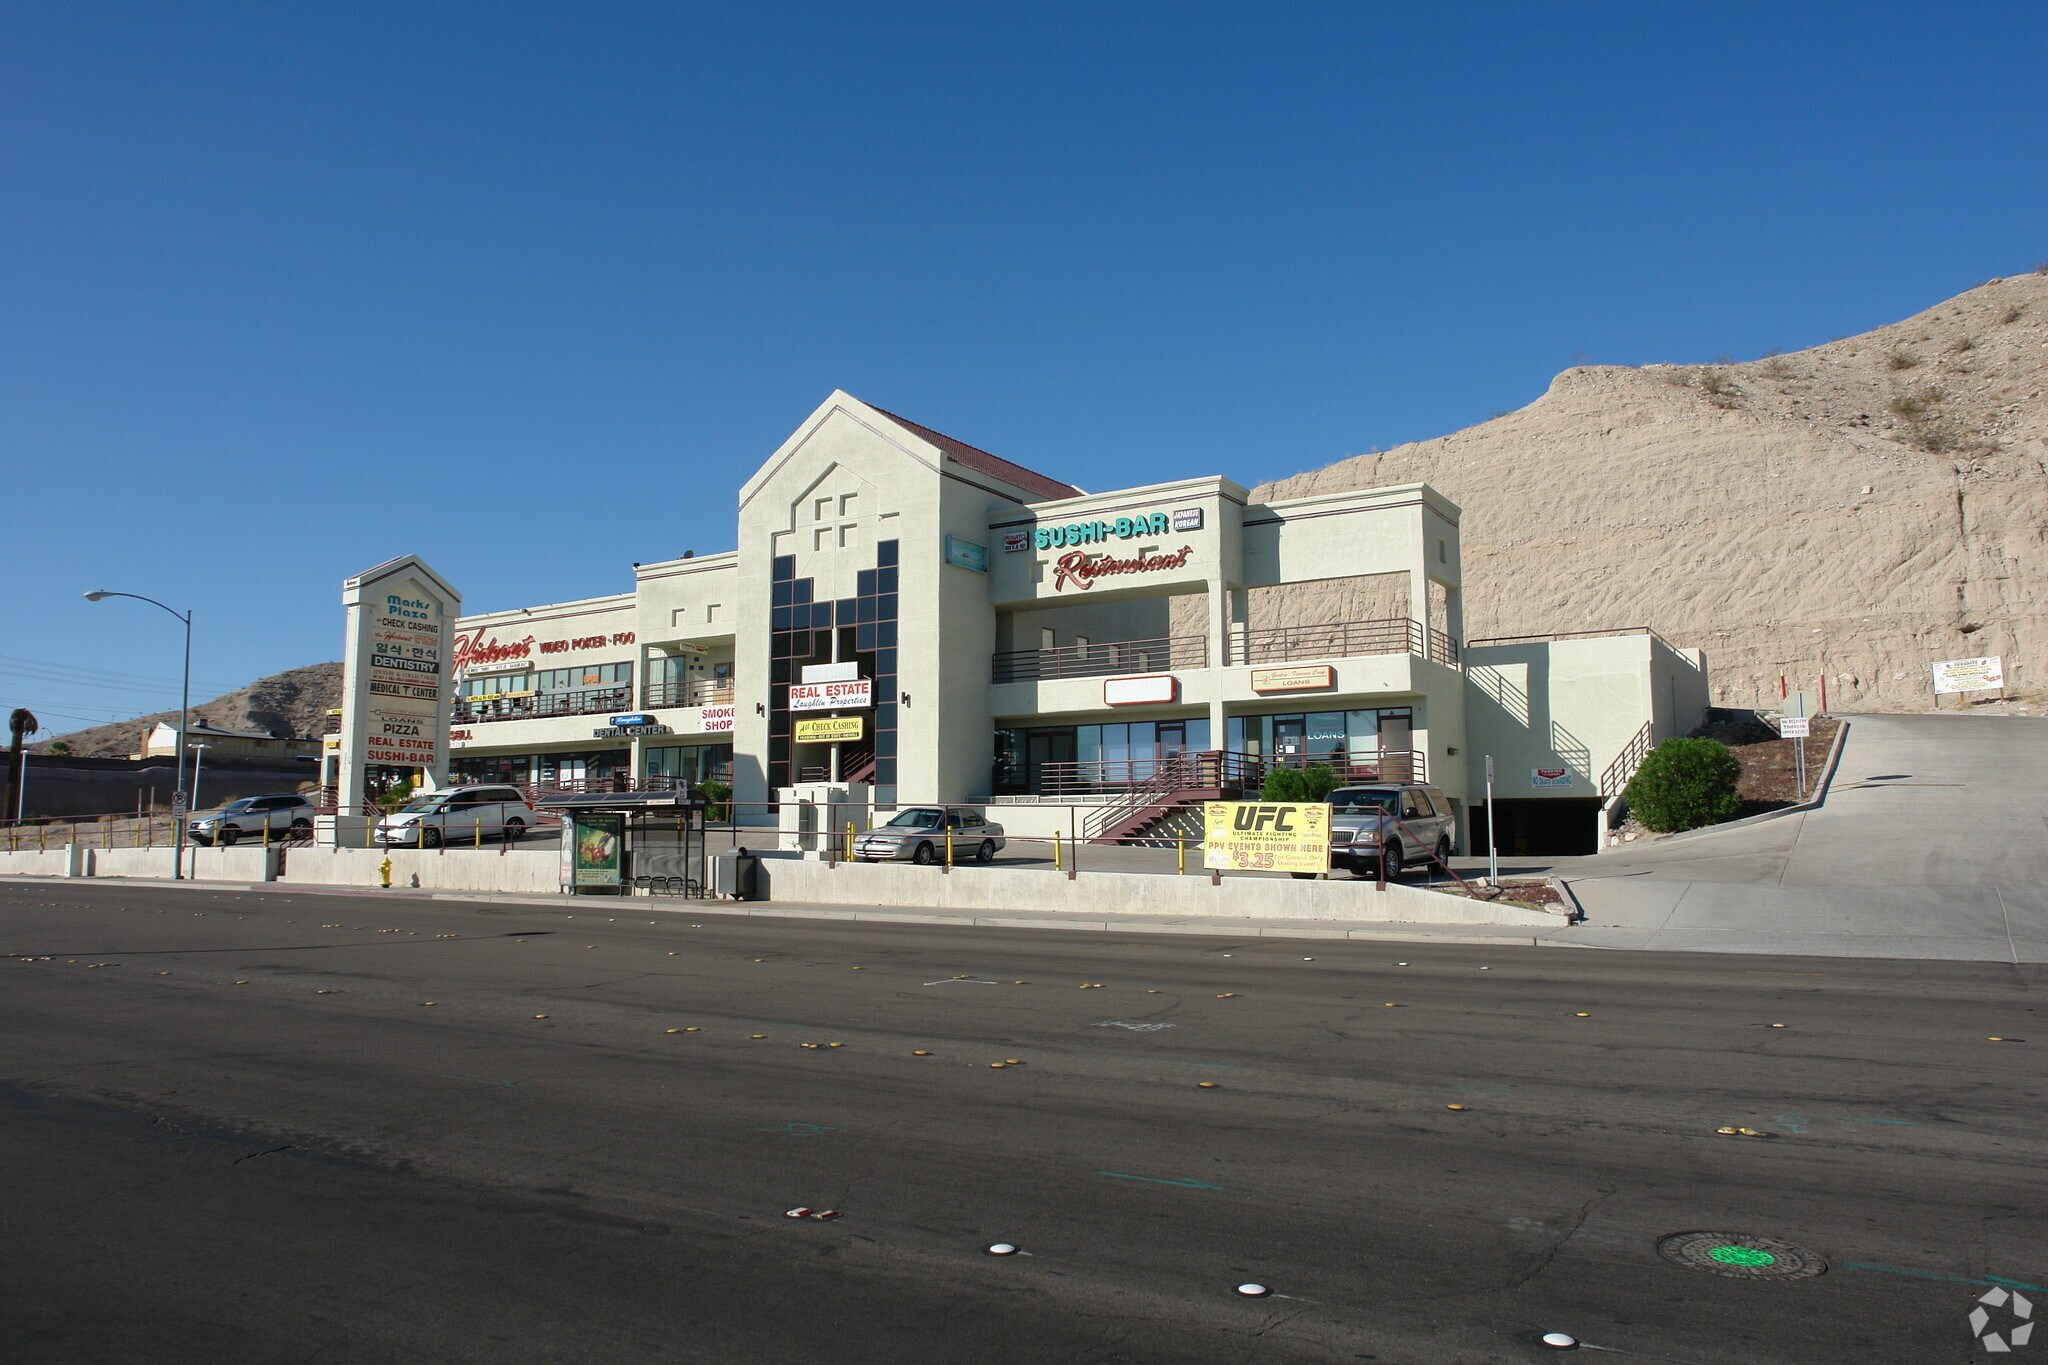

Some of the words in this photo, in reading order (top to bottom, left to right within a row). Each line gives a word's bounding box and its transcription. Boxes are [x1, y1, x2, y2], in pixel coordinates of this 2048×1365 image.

[1174, 509, 1199, 519] JAPANESE
[1034, 512, 1168, 549] SUSHI-BAR
[1174, 518, 1199, 529] KOREAN
[1053, 544, 1193, 592] Restaurant
[387, 594, 431, 610] Marks
[388, 605, 428, 620] Plaza
[382, 617, 405, 629] CHECK
[408, 621, 439, 634] CASHING
[539, 639, 570, 655] VIDEO
[571, 635, 607, 651] POKER
[374, 656, 436, 672] DENTISTRY
[370, 682, 401, 695] MEDICAL
[412, 687, 438, 699] CENTER
[791, 687, 821, 699] REAL
[826, 682, 869, 697] ESTATE
[793, 699, 825, 709] Laughlin
[830, 697, 867, 706] Properties
[381, 716, 424, 725] LOANS
[705, 719, 733, 731] SHOP
[383, 723, 420, 736] PIZZA
[592, 727, 627, 739] DENTAL
[629, 725, 667, 736] CENTER
[1307, 731, 1345, 740] LOANS
[368, 736, 395, 747] REAL
[399, 738, 435, 750] ESTATE
[1233, 806, 1297, 831] UFC
[1208, 841, 1226, 850] PPV
[1228, 842, 1262, 851] EVENTS
[1264, 843, 1297, 852] SHOWN
[1300, 844, 1324, 853] HERE
[1232, 850, 1275, 869] $3.25
